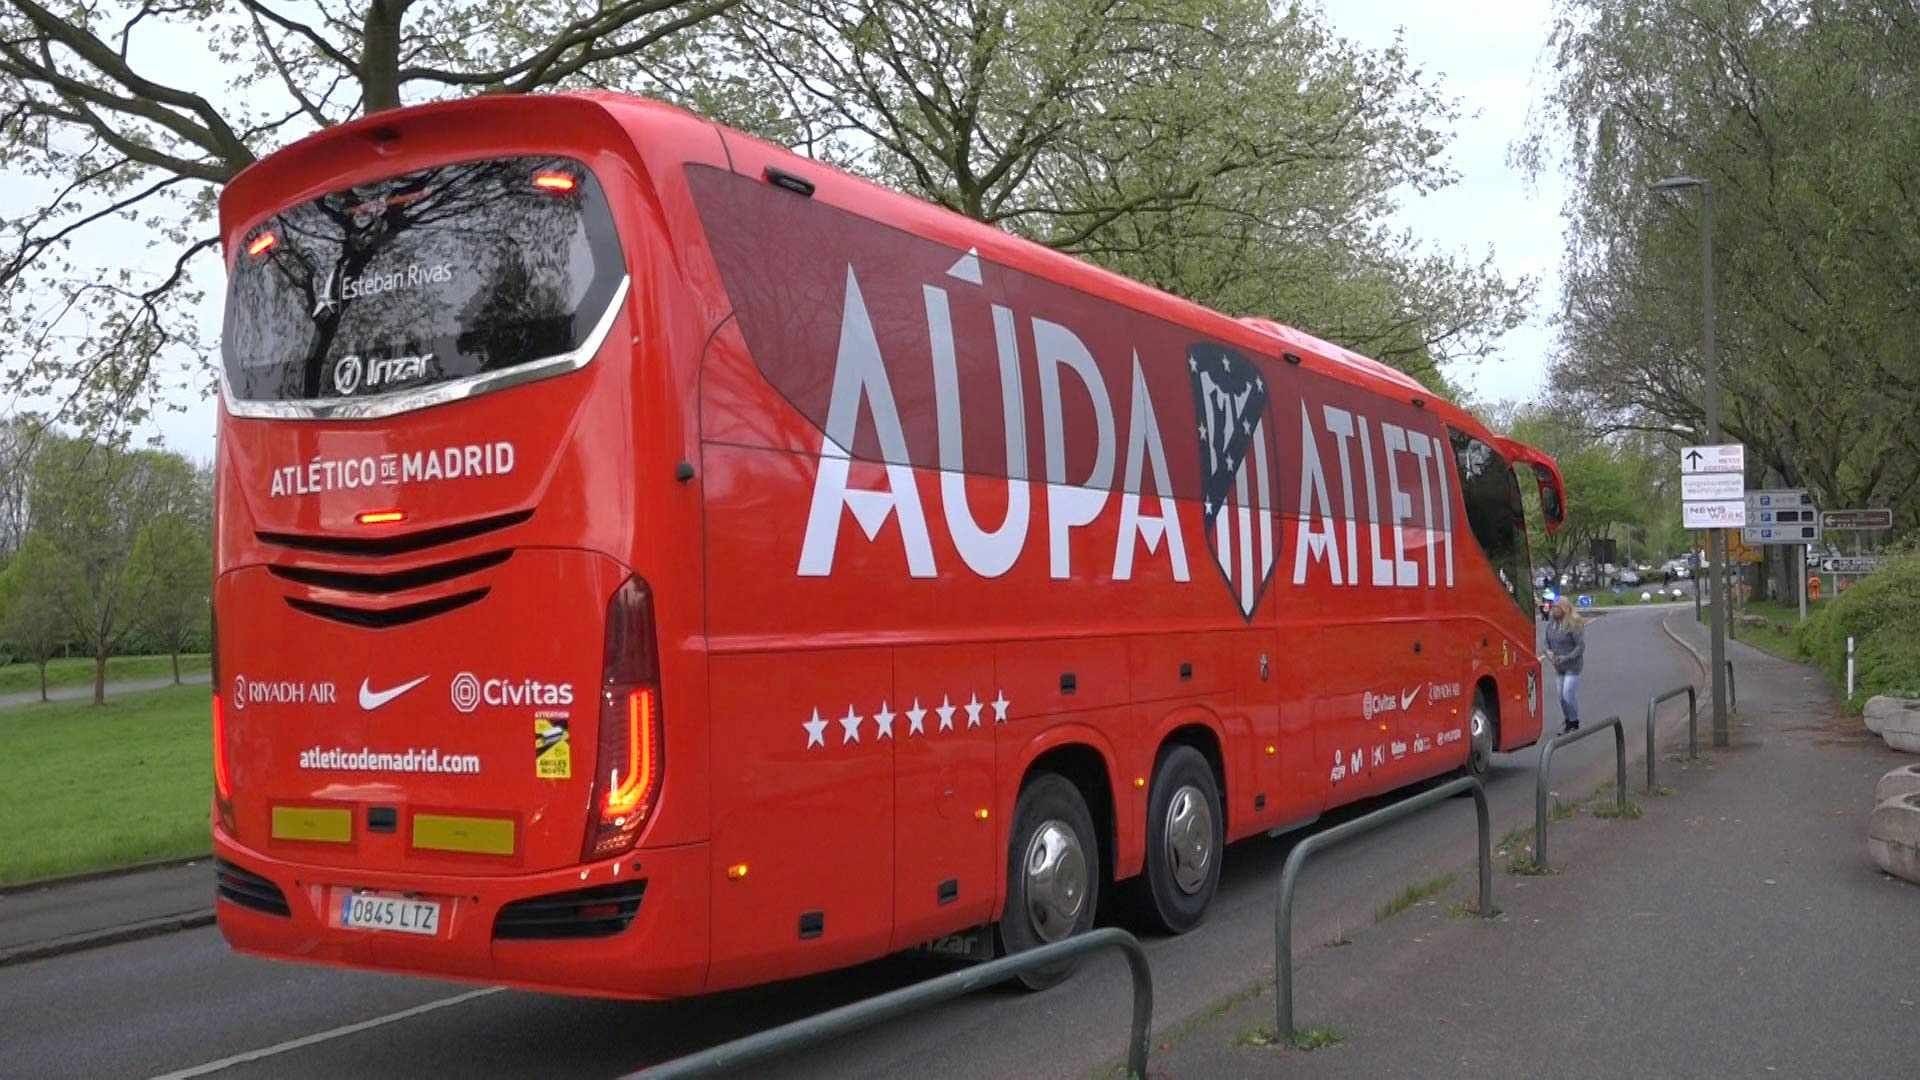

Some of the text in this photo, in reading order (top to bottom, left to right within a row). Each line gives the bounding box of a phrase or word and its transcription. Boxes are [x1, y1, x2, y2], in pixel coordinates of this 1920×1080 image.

[342, 263, 453, 300] Esteban Rivas
[366, 353, 433, 386] Irizar
[270, 442, 515, 497] ATLÉTICO DE MADRID
[1292, 396, 1455, 588] ATLETI
[249, 682, 336, 703] RIYADH AIR
[300, 746, 480, 774] atleticodemadrid.com
[353, 899, 434, 930] 0845 LTZ
